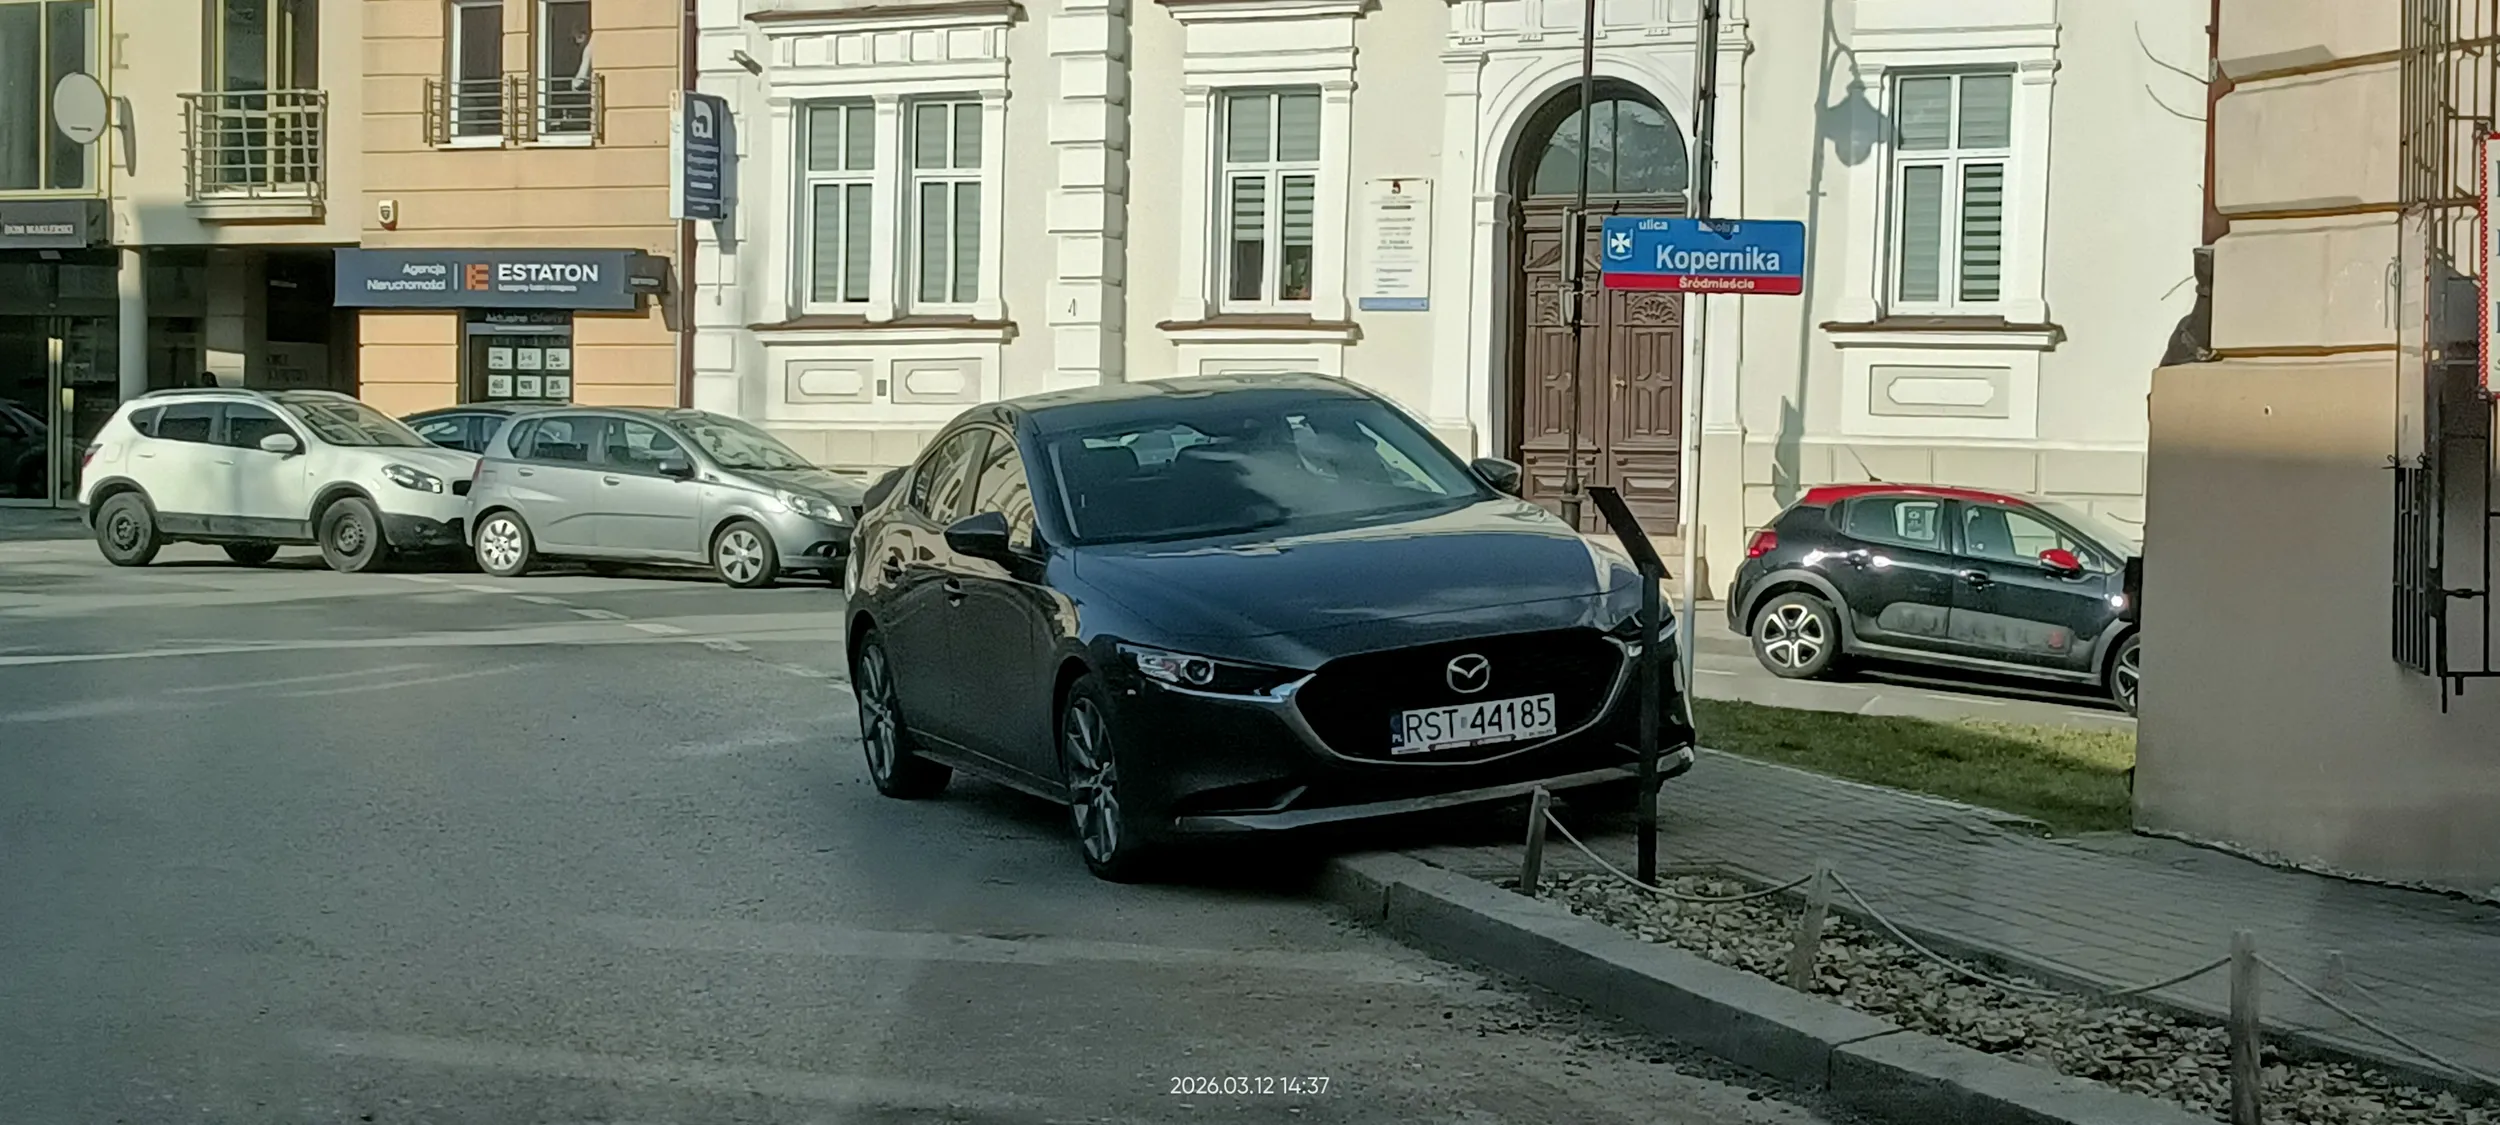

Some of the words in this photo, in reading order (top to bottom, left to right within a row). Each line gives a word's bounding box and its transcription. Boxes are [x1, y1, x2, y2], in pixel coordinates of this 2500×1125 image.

[1638, 218, 1668, 231] ulica
[1656, 244, 1781, 275] Kopernika
[402, 262, 447, 276] Agencja
[497, 263, 599, 282] ESTATON
[366, 278, 447, 291] Nieruchomości
[1678, 275, 1755, 290] Śródmieście
[1405, 708, 1459, 743] RST
[1469, 697, 1552, 734] 44185
